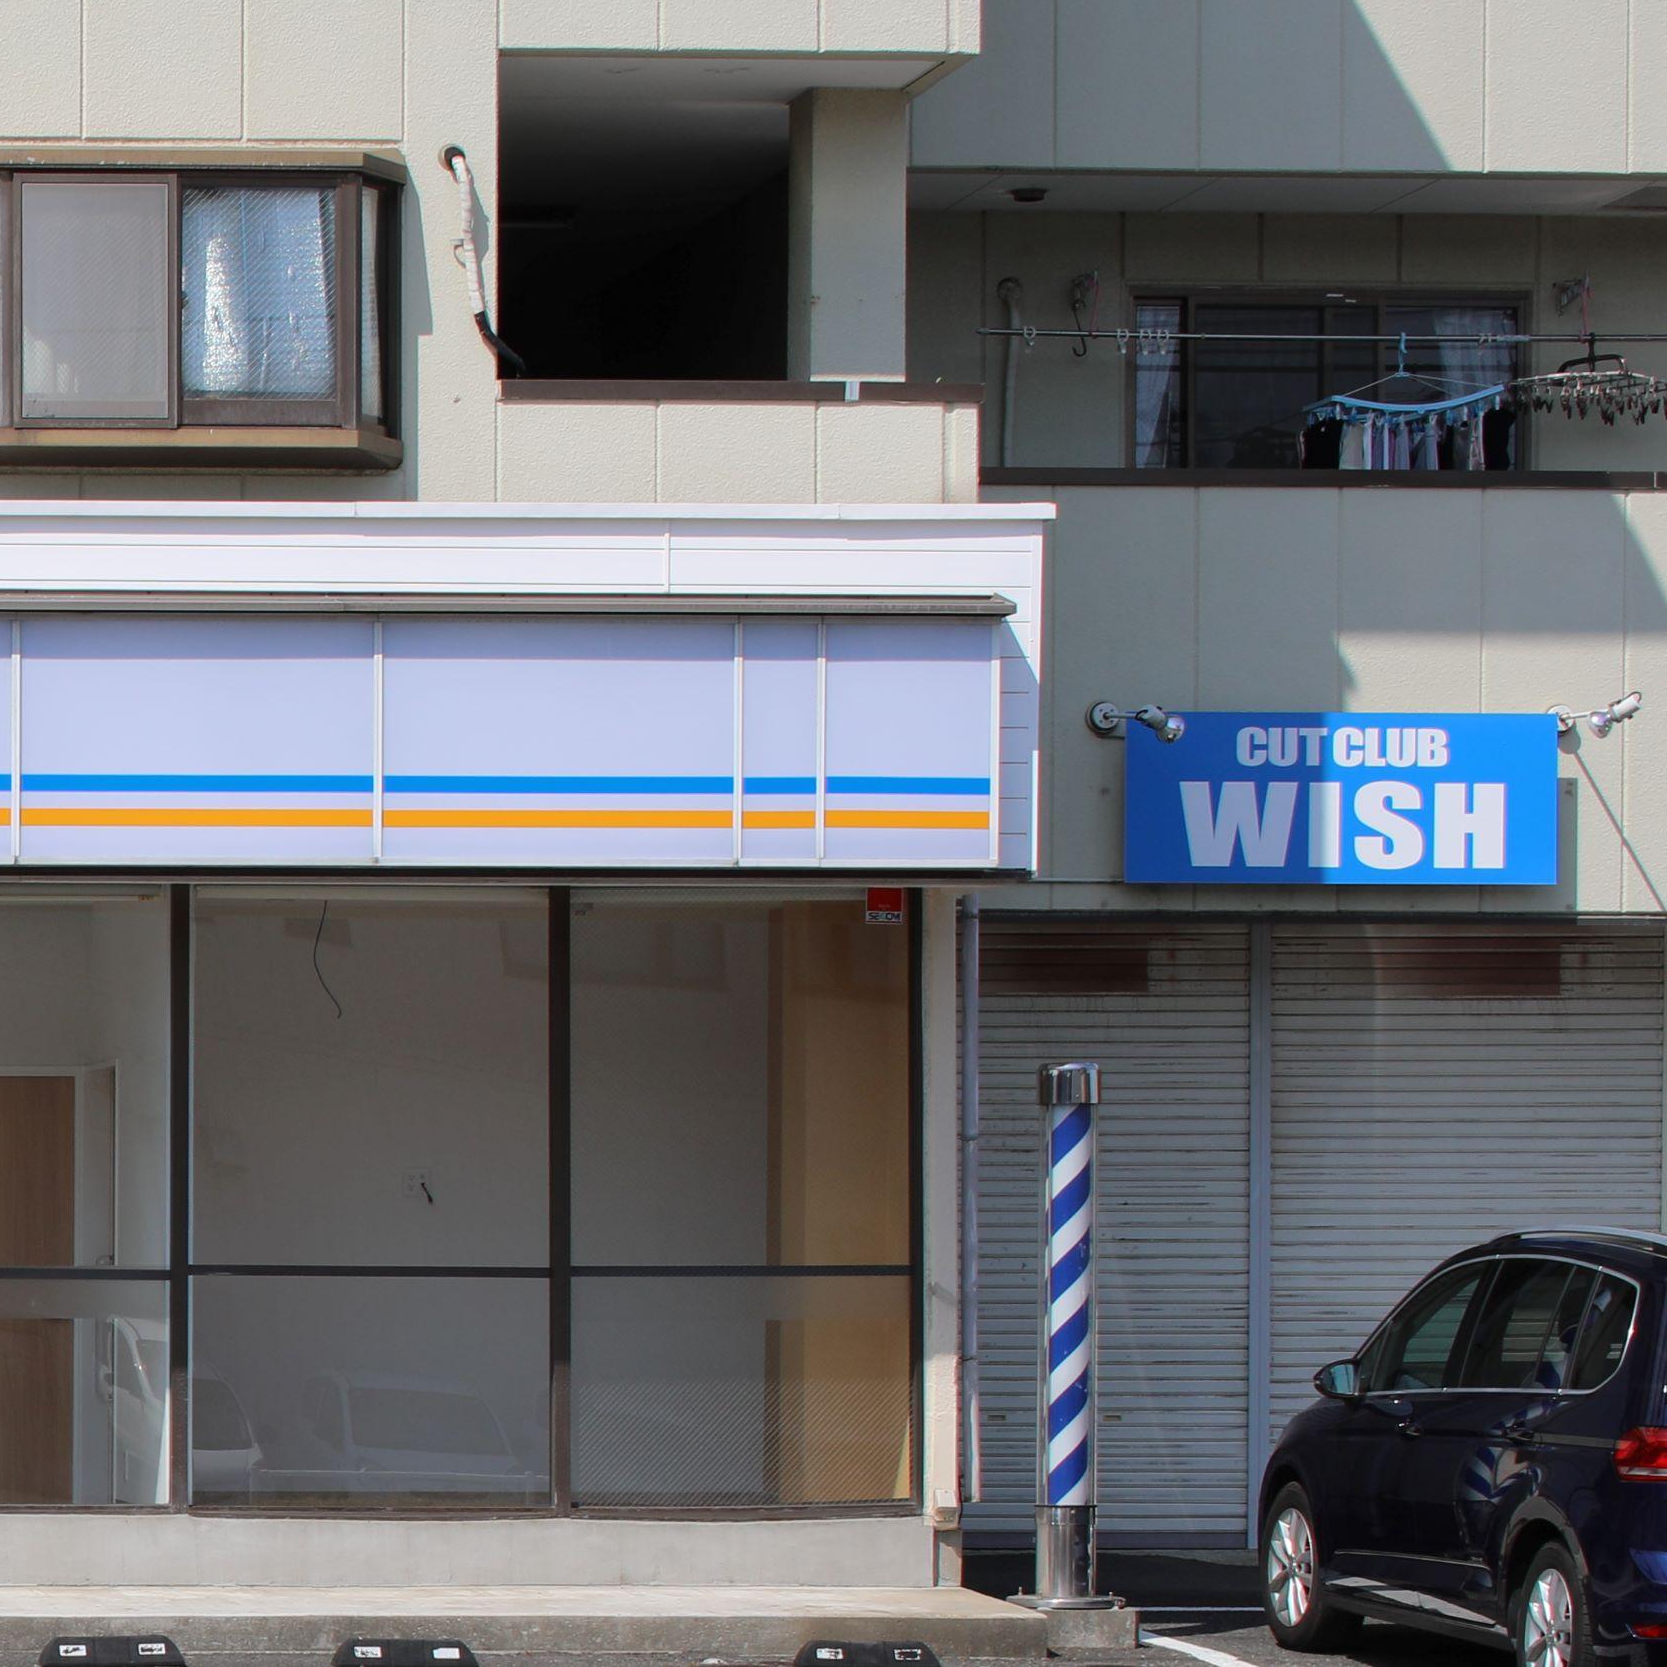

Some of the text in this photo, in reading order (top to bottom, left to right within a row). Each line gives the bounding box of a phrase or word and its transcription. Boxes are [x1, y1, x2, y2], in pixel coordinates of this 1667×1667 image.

[1236, 726, 1448, 767] CUT CLUB
[1179, 780, 1505, 869] WISH
